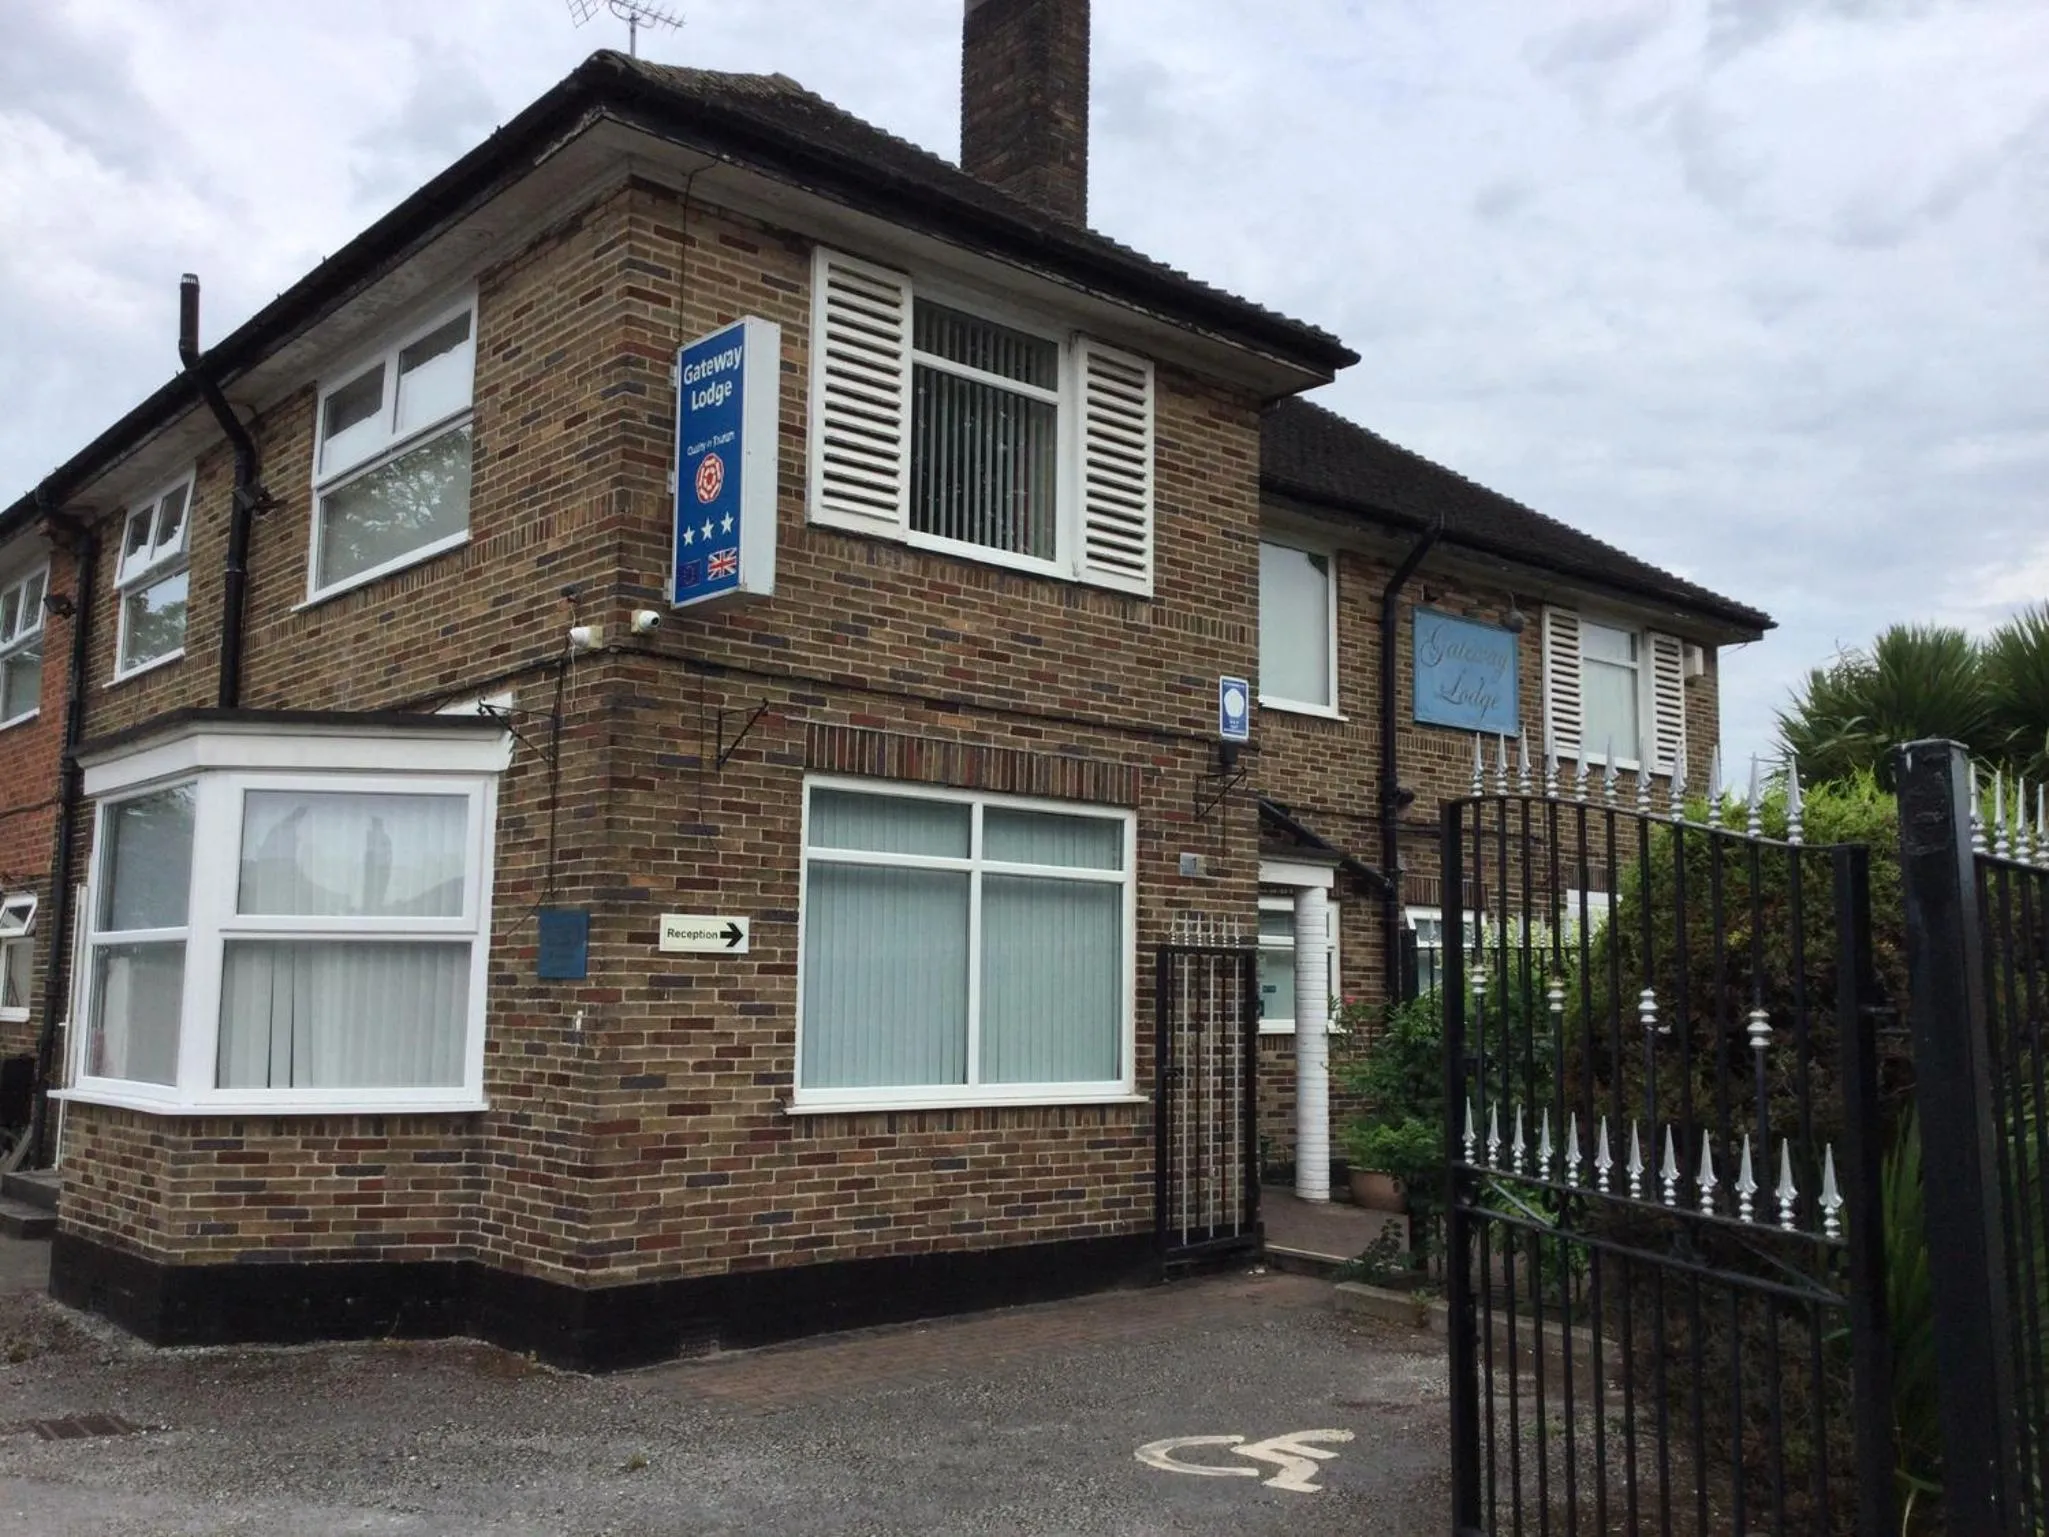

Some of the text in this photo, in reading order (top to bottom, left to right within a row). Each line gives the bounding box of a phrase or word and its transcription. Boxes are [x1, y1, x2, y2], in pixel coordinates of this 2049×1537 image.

[684, 346, 742, 384] Gateway
[692, 381, 732, 410] Lodge
[1420, 621, 1508, 684] Gateway
[1438, 667, 1497, 722] Lodge
[667, 928, 718, 940] Reception
